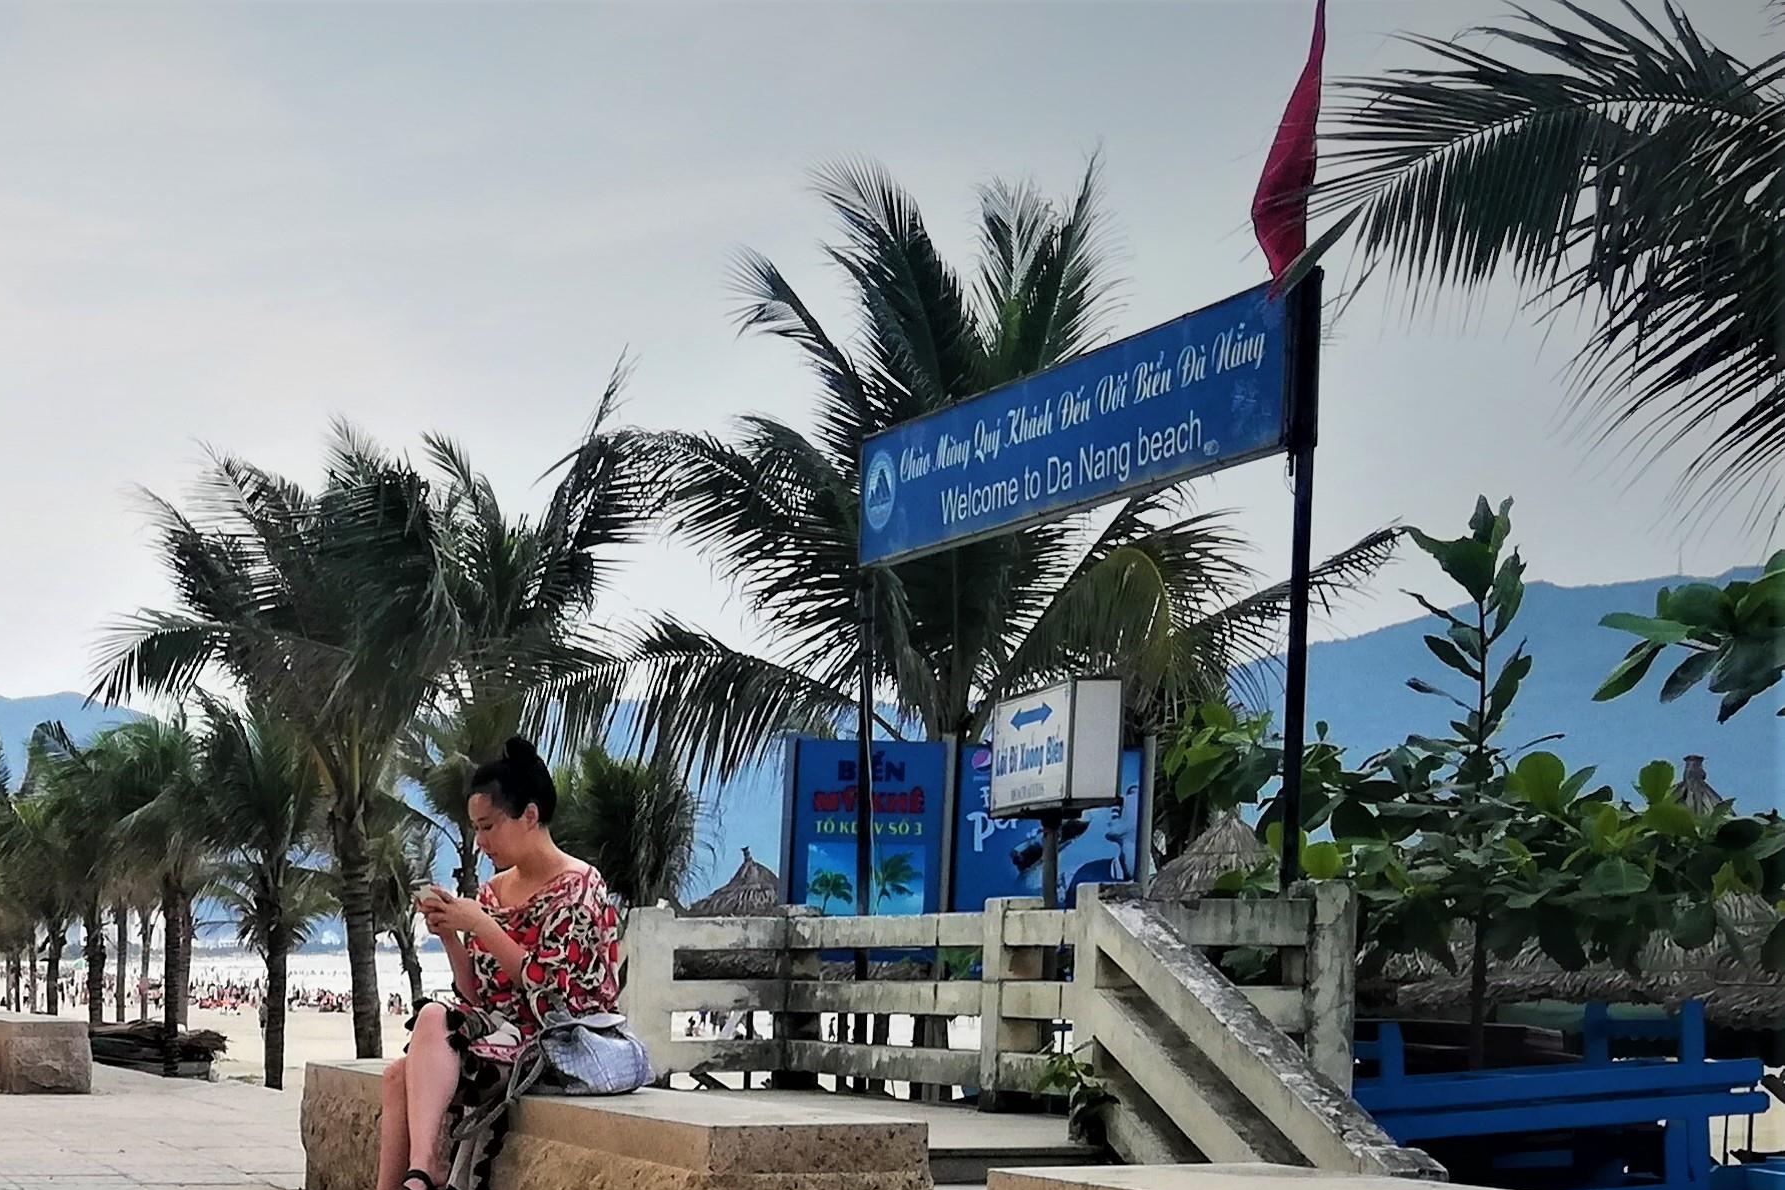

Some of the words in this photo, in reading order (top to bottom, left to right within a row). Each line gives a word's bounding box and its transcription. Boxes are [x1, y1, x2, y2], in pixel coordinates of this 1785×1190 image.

[1177, 344, 1206, 388] Đà
[941, 477, 1018, 524] Welcome
[1024, 466, 1041, 500] to
[1047, 456, 1072, 494] Da
[1079, 442, 1131, 482] Nang
[1138, 410, 1201, 467] beach
[838, 751, 905, 781] BỂN
